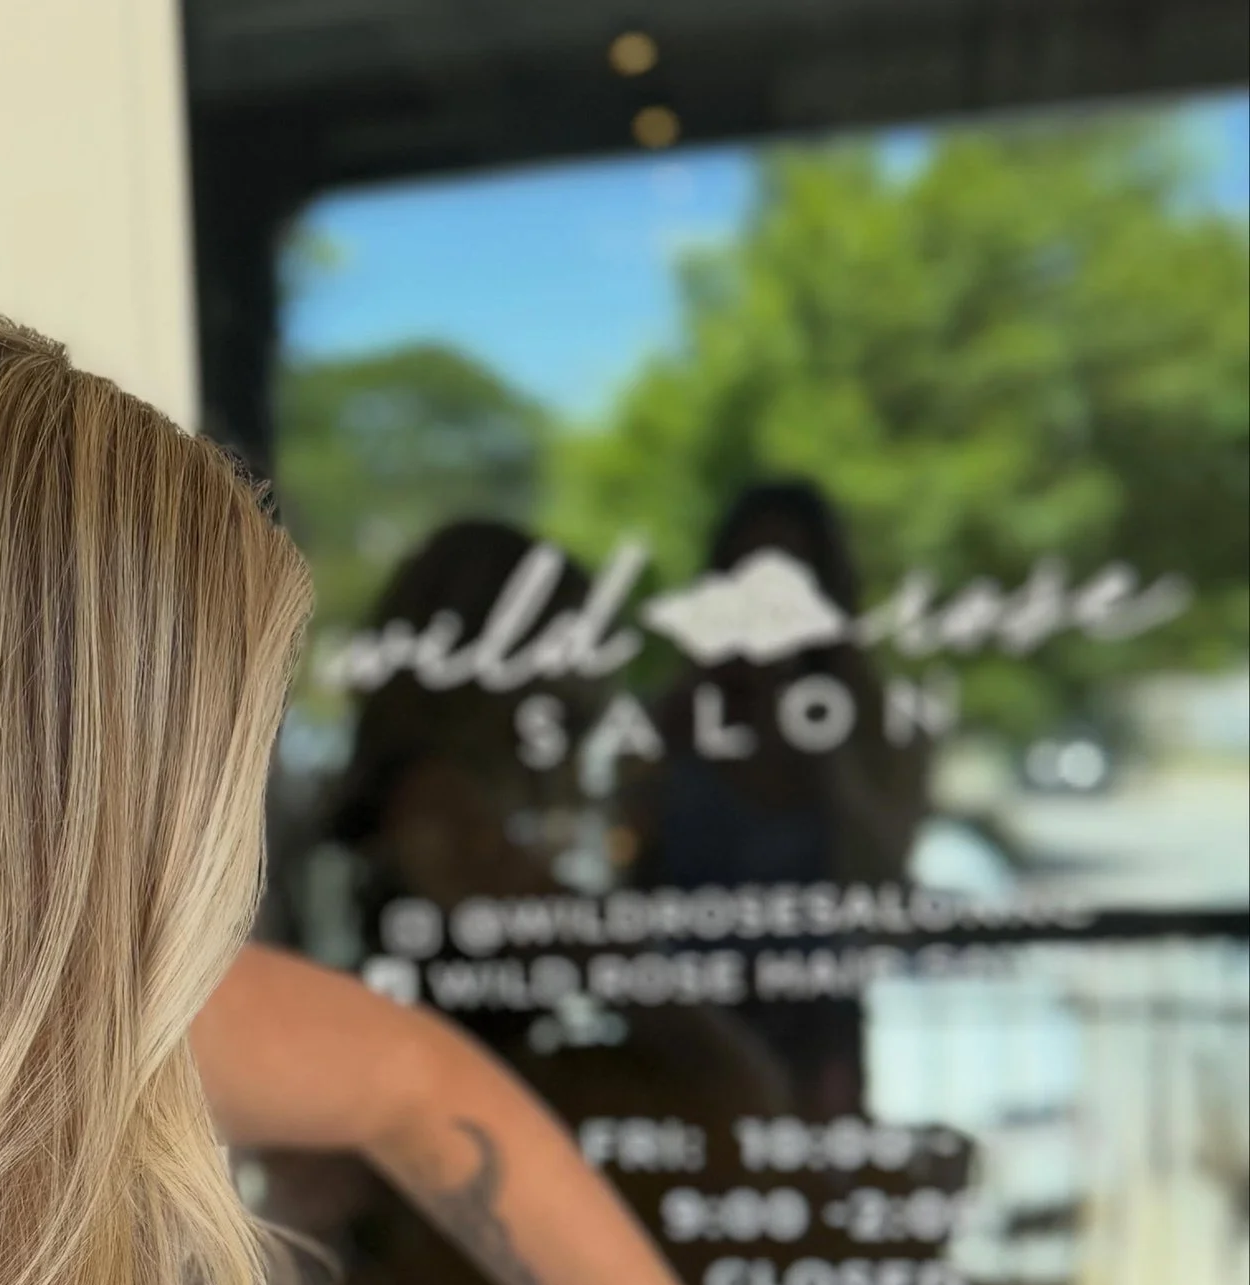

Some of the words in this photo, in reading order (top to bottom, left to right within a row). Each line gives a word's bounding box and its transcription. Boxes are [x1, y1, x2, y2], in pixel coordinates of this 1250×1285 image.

[318, 536, 648, 692] wild
[514, 668, 962, 772] SALON
[427, 954, 582, 1010] WILD
[588, 946, 750, 1006] ROSE
